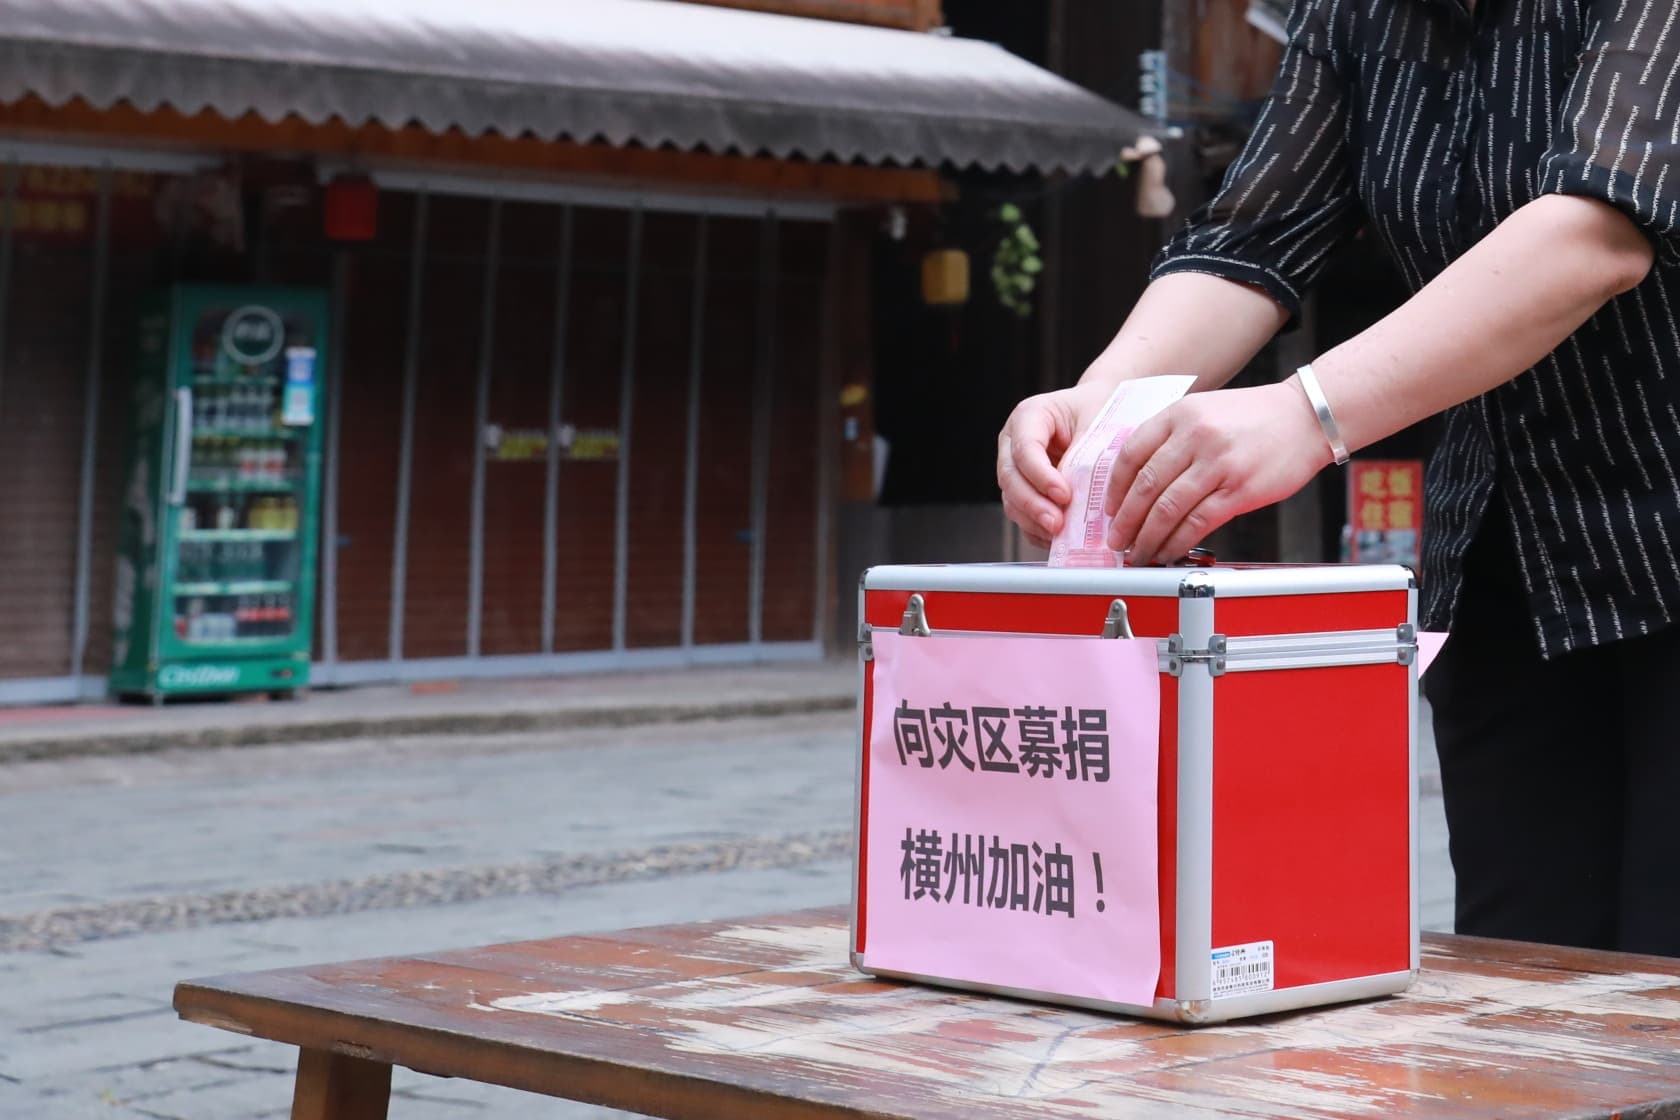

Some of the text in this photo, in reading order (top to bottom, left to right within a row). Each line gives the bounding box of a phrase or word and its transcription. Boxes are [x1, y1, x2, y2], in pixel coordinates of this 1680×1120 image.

[893, 698, 1111, 783] 向灾区募捐
[900, 827, 1106, 919] 横州加油！
